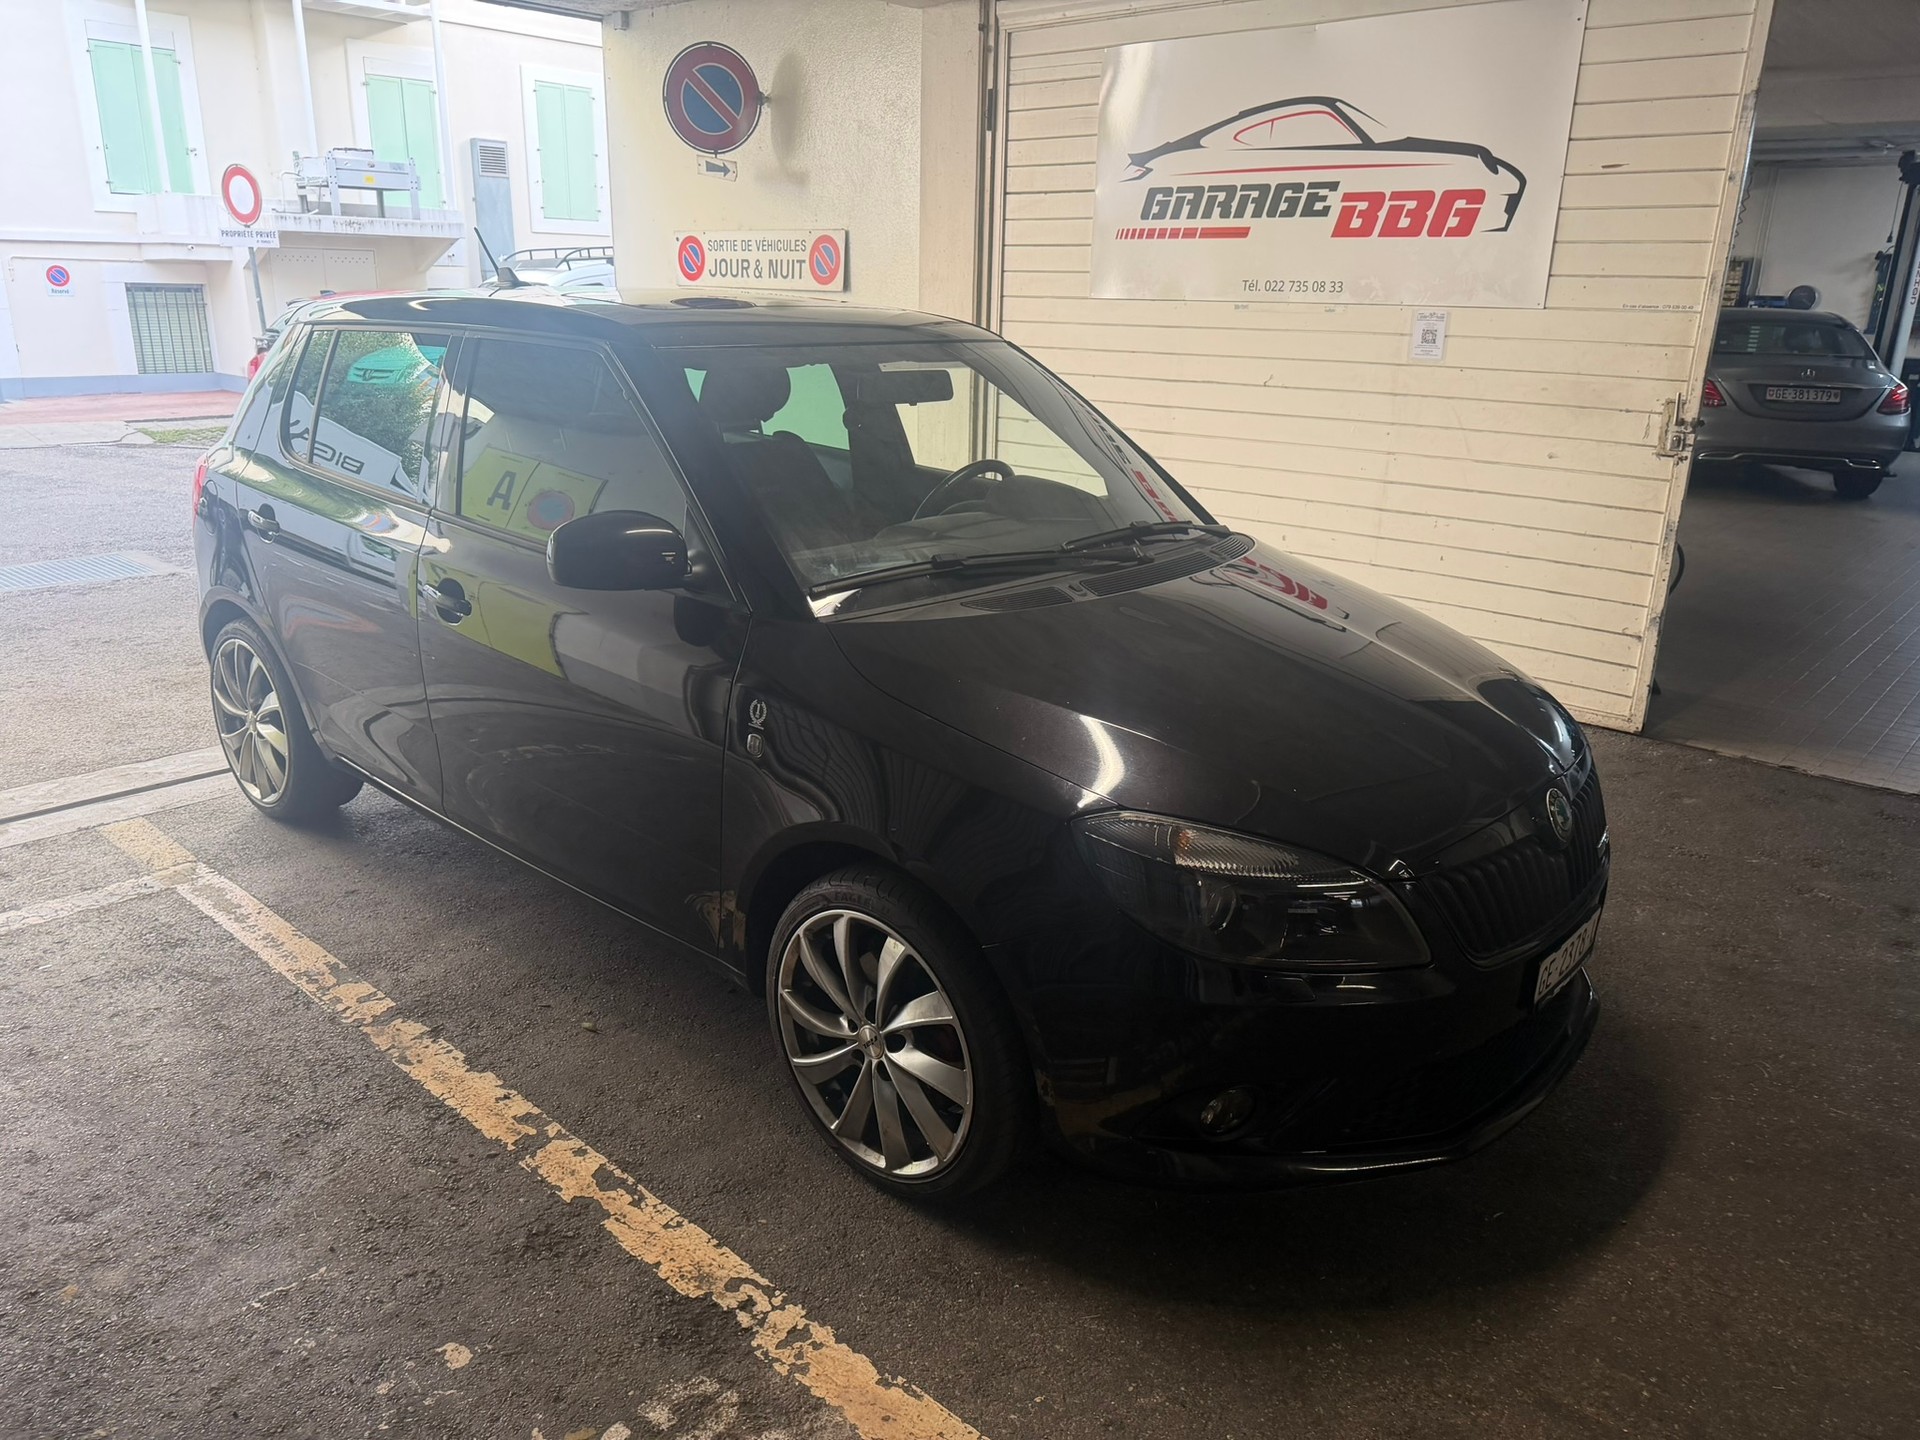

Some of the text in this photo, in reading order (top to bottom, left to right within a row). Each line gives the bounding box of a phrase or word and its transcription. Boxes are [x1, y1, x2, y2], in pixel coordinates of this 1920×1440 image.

[1140, 181, 1486, 238] GARAGE BBG
[707, 237, 807, 252] SORTIE DE VÉHICULES
[708, 258, 807, 280] JOUR & NUIT
[1242, 279, 1344, 293] Tél. 022 735 08 33
